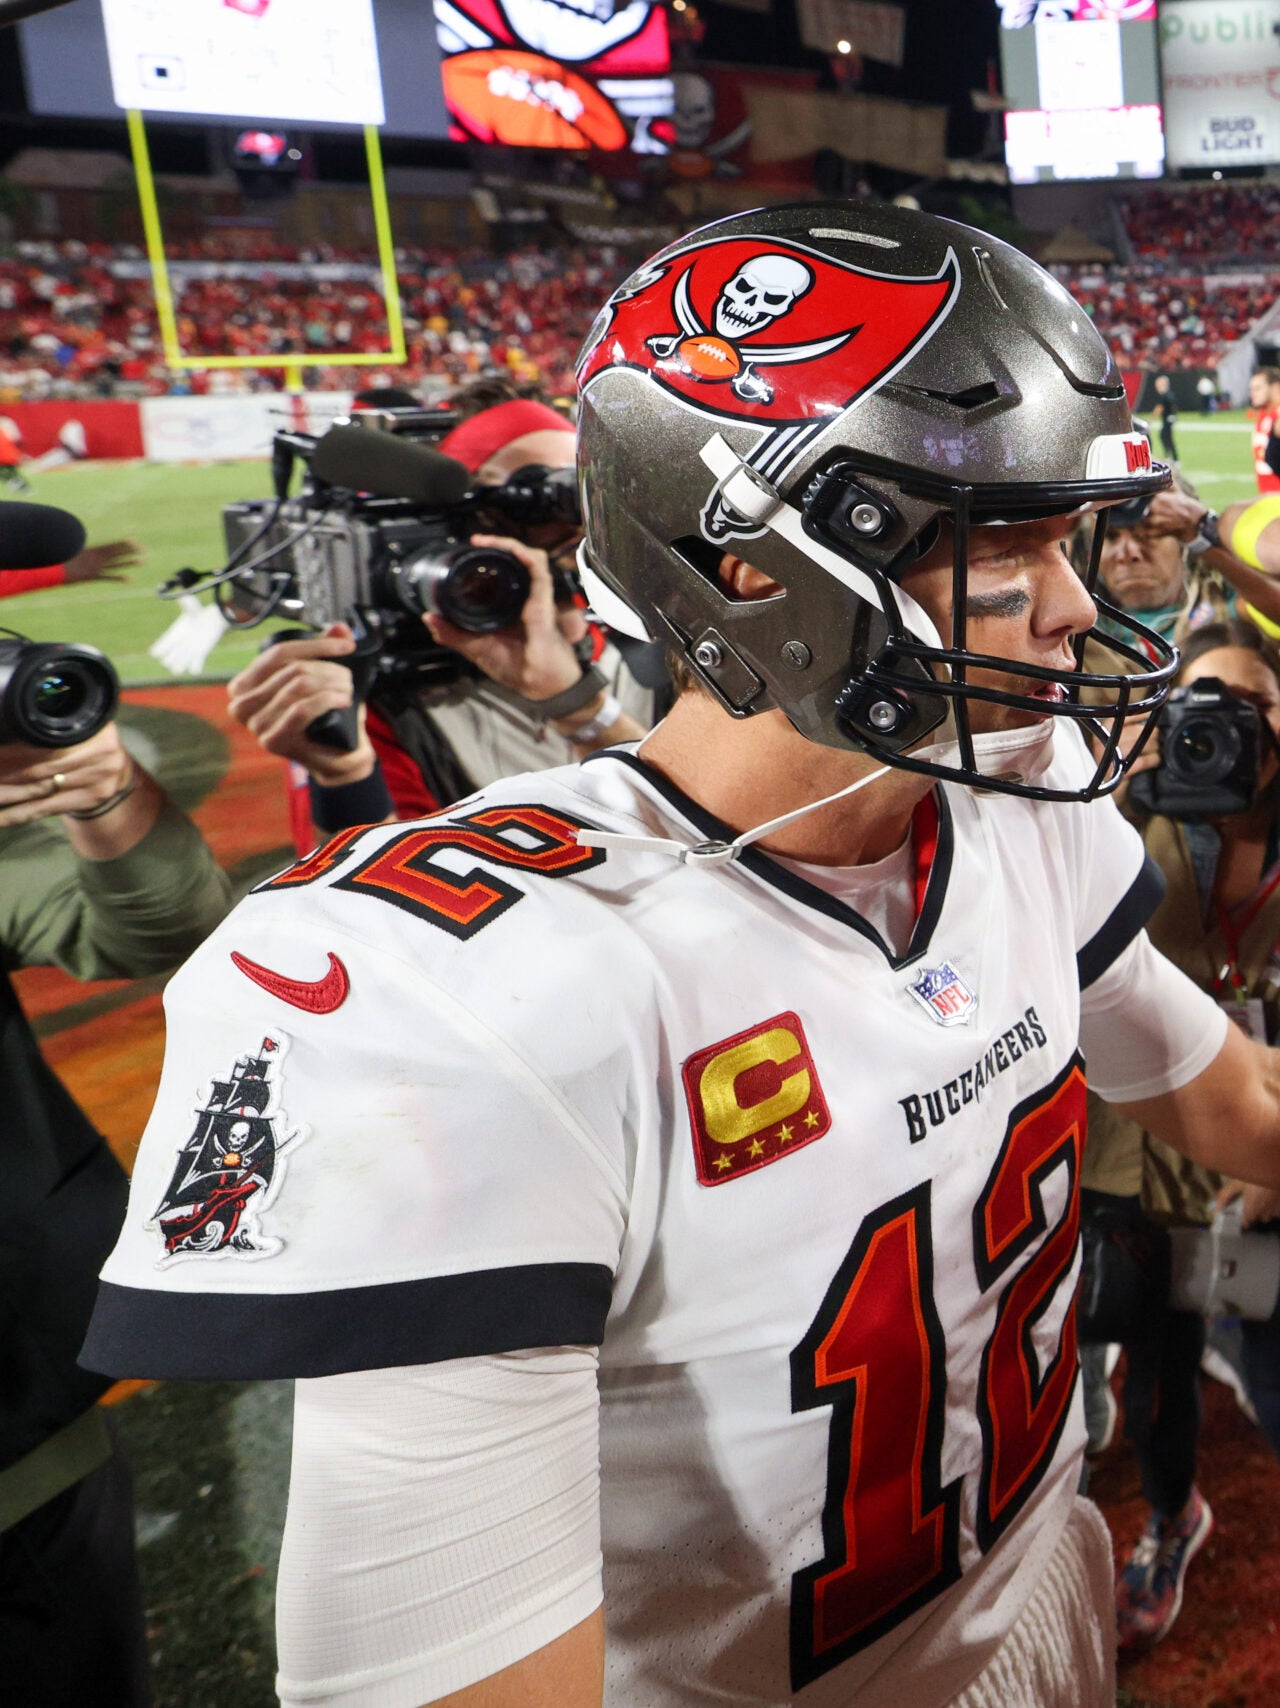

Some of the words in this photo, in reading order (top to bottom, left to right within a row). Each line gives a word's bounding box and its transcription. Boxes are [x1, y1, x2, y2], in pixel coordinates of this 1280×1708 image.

[1160, 10, 1280, 43] Publi
[1210, 115, 1256, 134] BUD
[1202, 134, 1264, 151] LIGHT
[931, 984, 971, 1017] NFL
[699, 1027, 812, 1144] C
[898, 1006, 1048, 1145] BUCCANEERS
[789, 1045, 1088, 1695] 12
